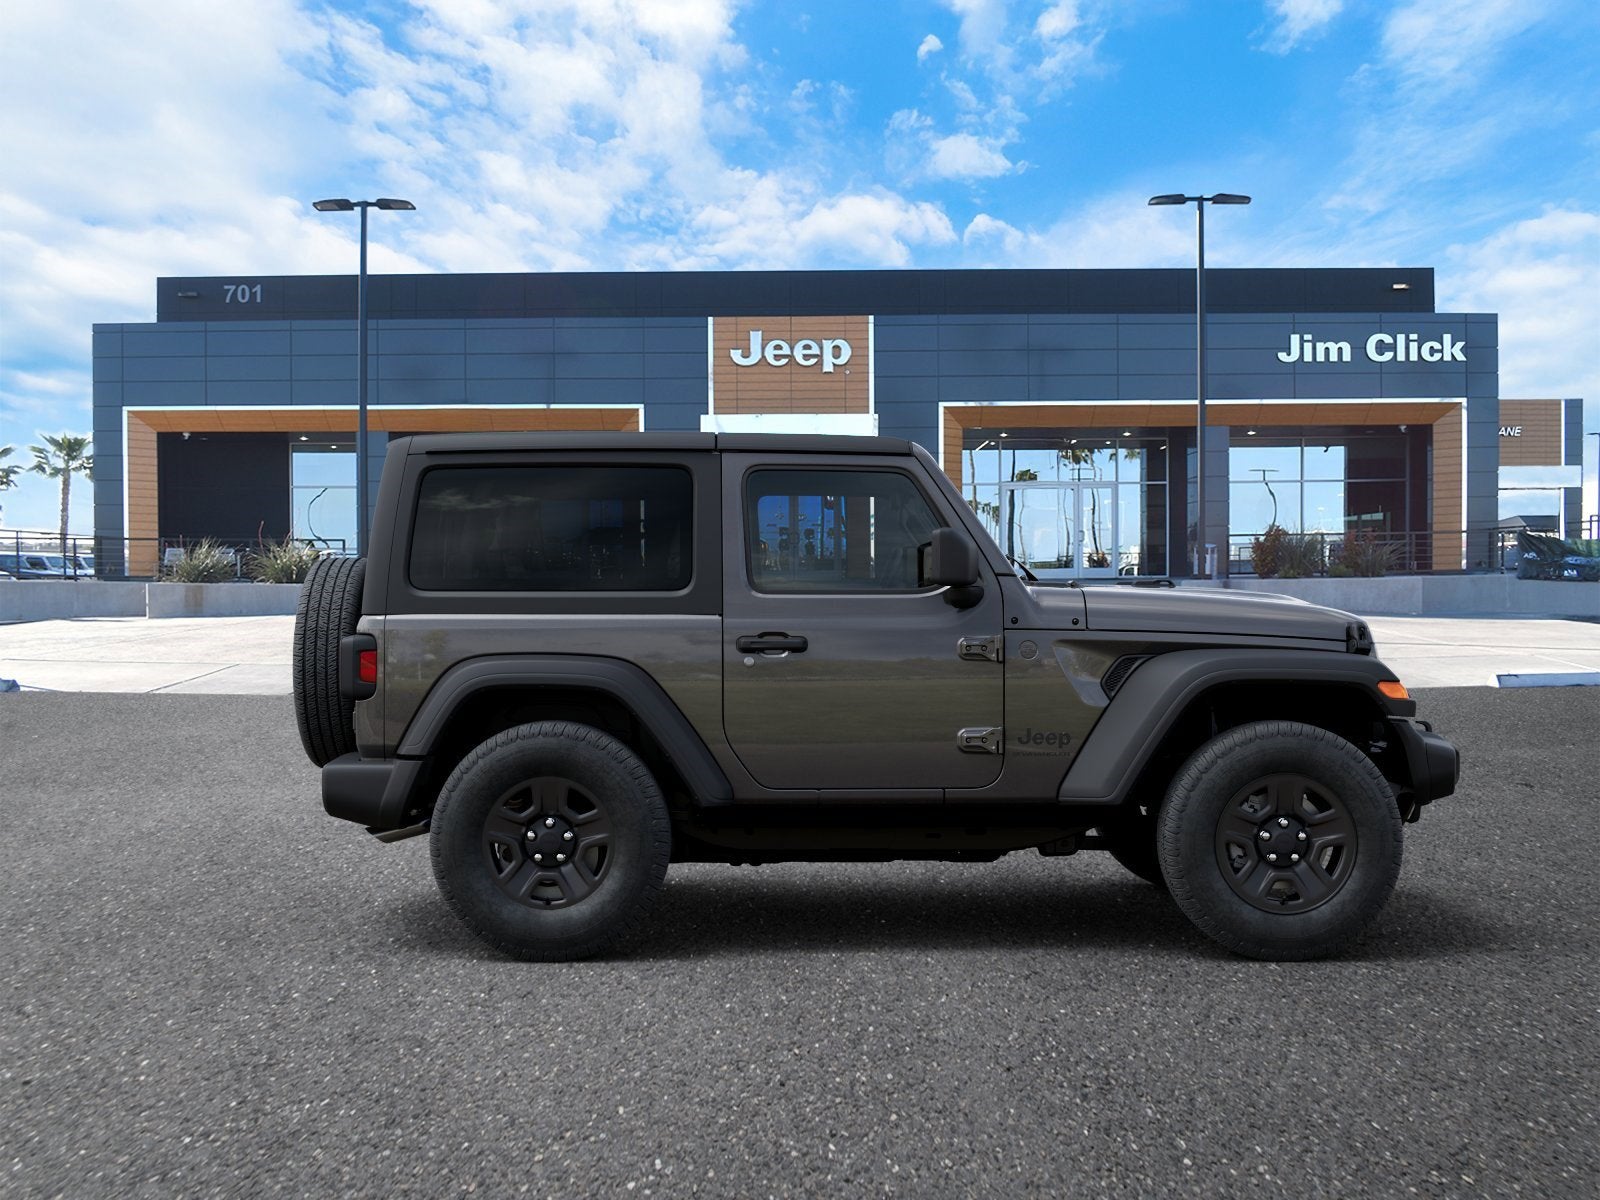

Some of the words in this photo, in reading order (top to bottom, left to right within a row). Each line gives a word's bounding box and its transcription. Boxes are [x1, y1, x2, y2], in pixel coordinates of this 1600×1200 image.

[224, 284, 262, 303] 701
[730, 330, 852, 374] Jeep
[1277, 334, 1352, 362] Jim
[1366, 333, 1467, 362] Click
[1018, 728, 1071, 748] Jeep
